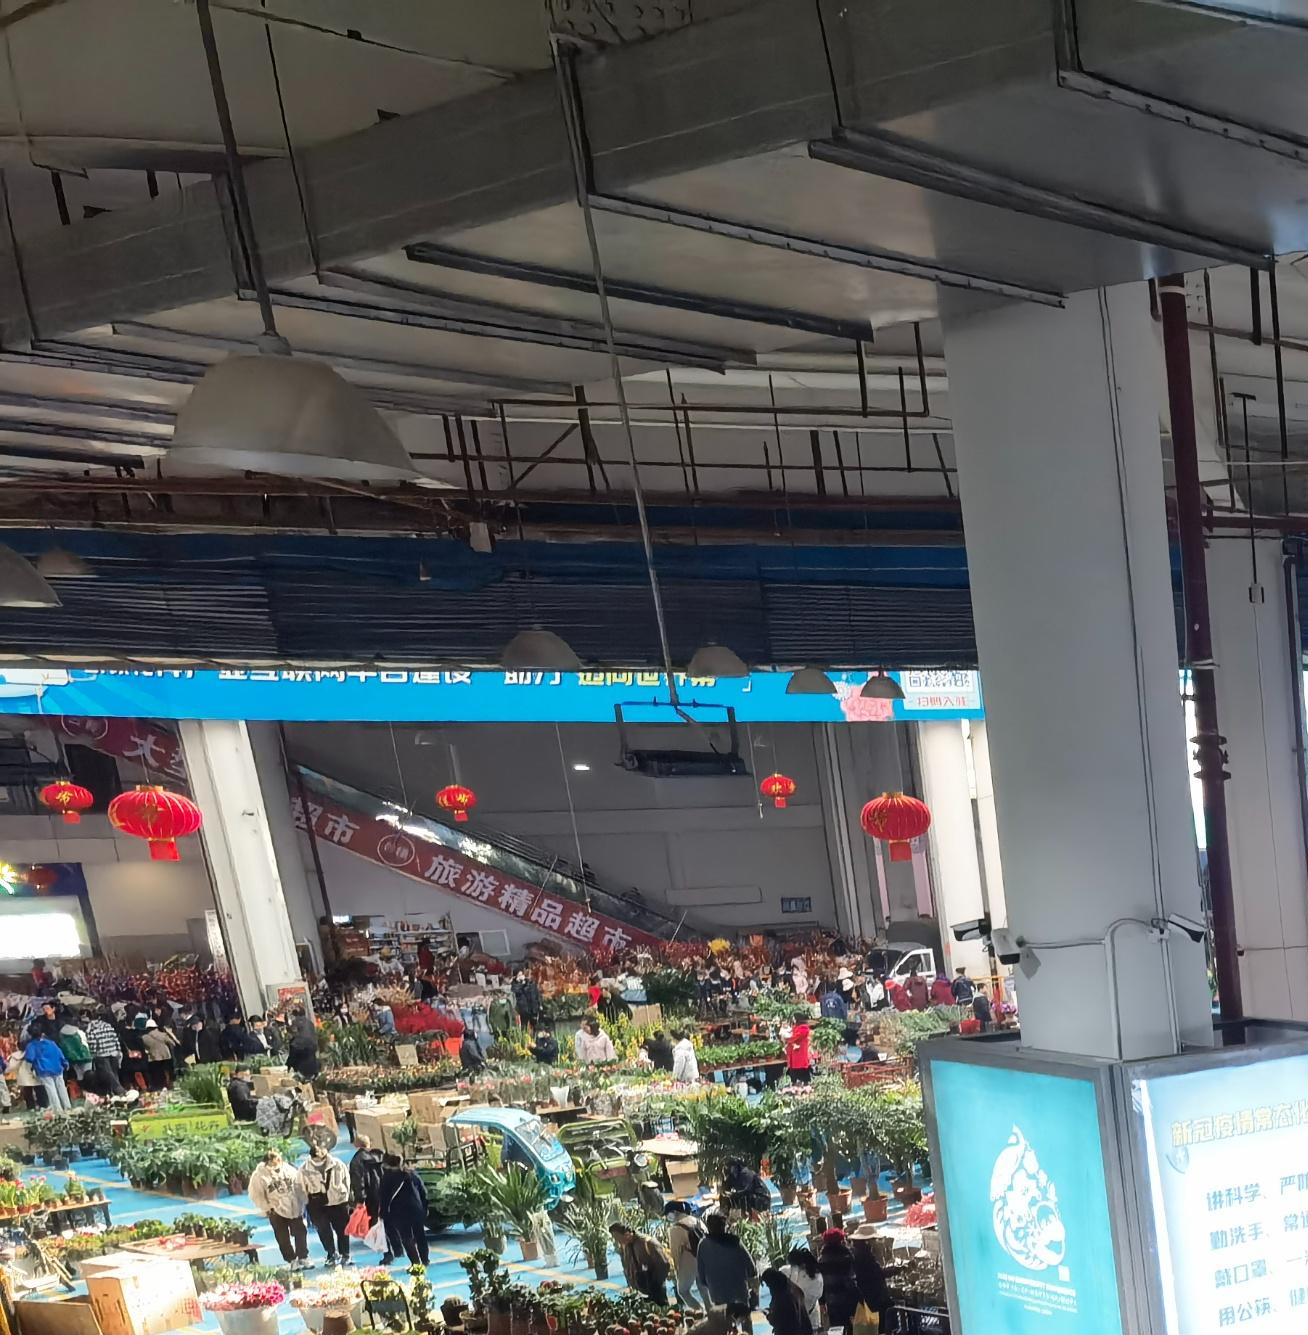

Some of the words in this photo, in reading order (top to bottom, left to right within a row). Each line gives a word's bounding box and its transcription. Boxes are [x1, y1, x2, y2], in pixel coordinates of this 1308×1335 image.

[424, 853, 632, 950] 旅游精品超市
